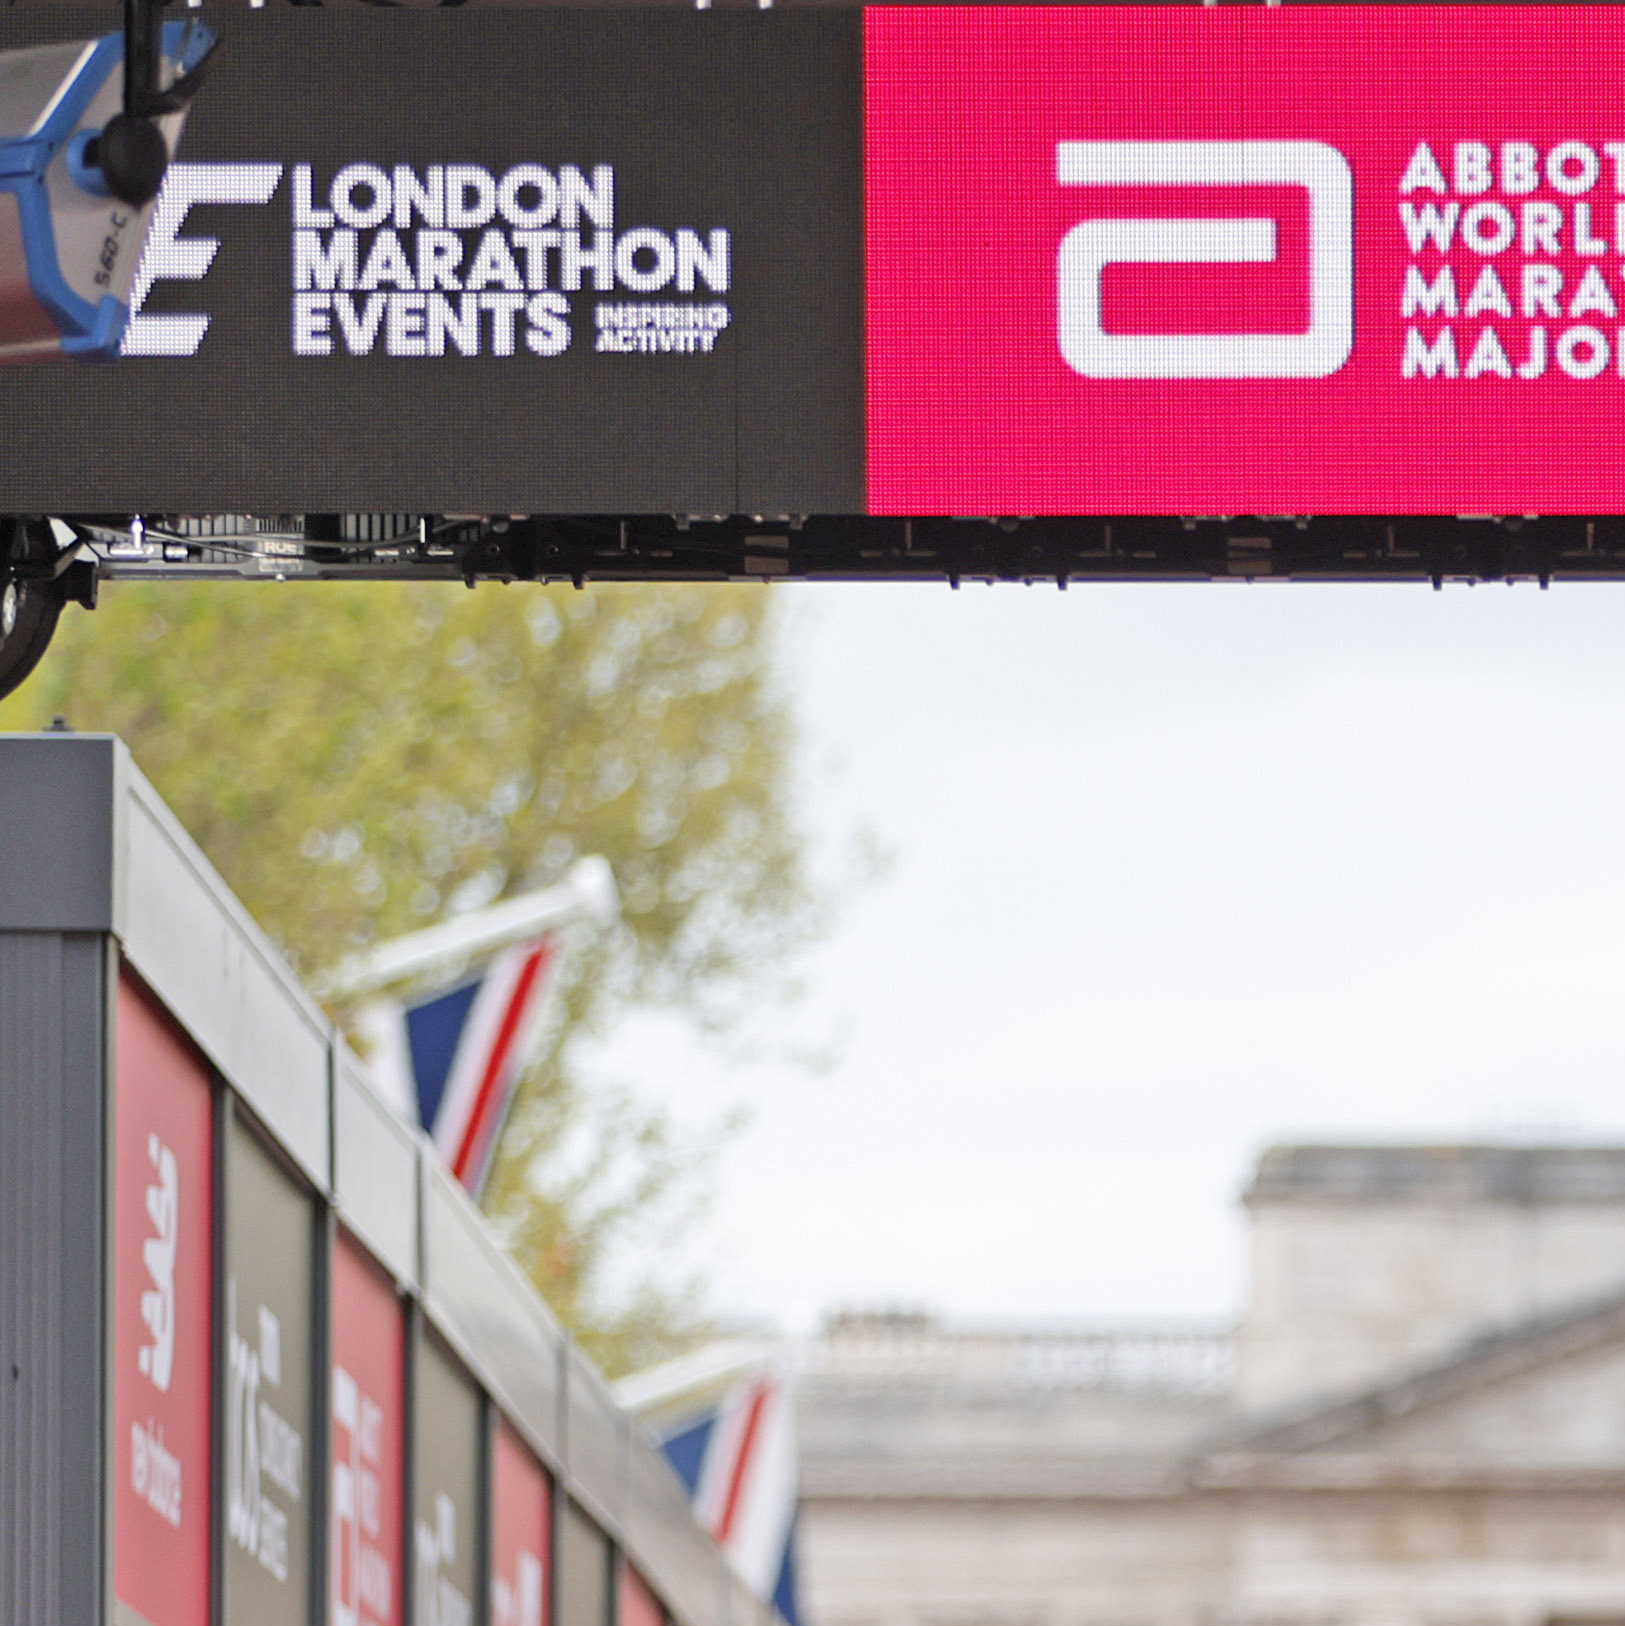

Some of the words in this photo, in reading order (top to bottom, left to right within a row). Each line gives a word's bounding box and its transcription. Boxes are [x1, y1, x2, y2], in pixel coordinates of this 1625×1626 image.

[292, 164, 614, 229] LONDON
[292, 228, 731, 292] MARATHON
[292, 292, 572, 356] EVENTS
